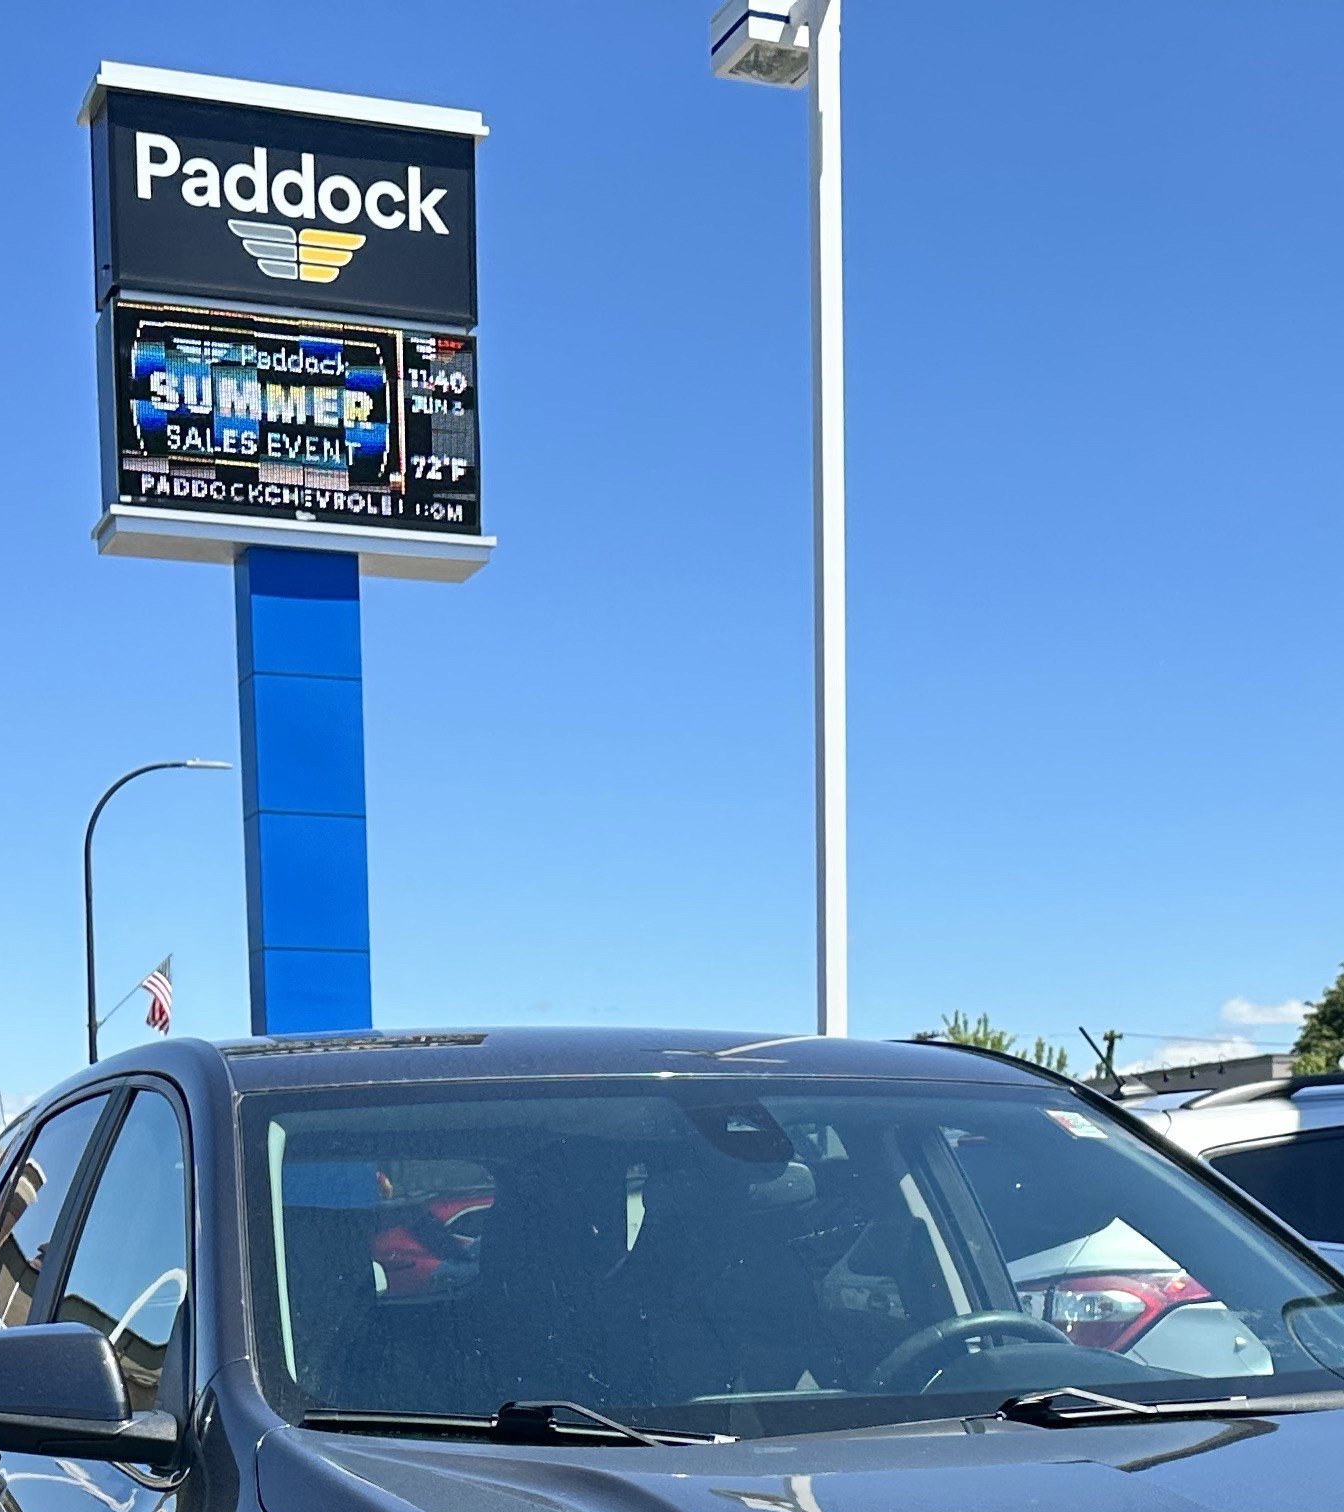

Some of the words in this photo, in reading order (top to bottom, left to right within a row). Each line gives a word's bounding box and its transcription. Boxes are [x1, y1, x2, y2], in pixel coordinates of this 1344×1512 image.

[135, 131, 449, 235] Paddock
[241, 345, 348, 377] Paddock
[150, 371, 373, 428] SUMMER
[166, 424, 257, 456] SALES
[267, 432, 361, 465] EVENT
